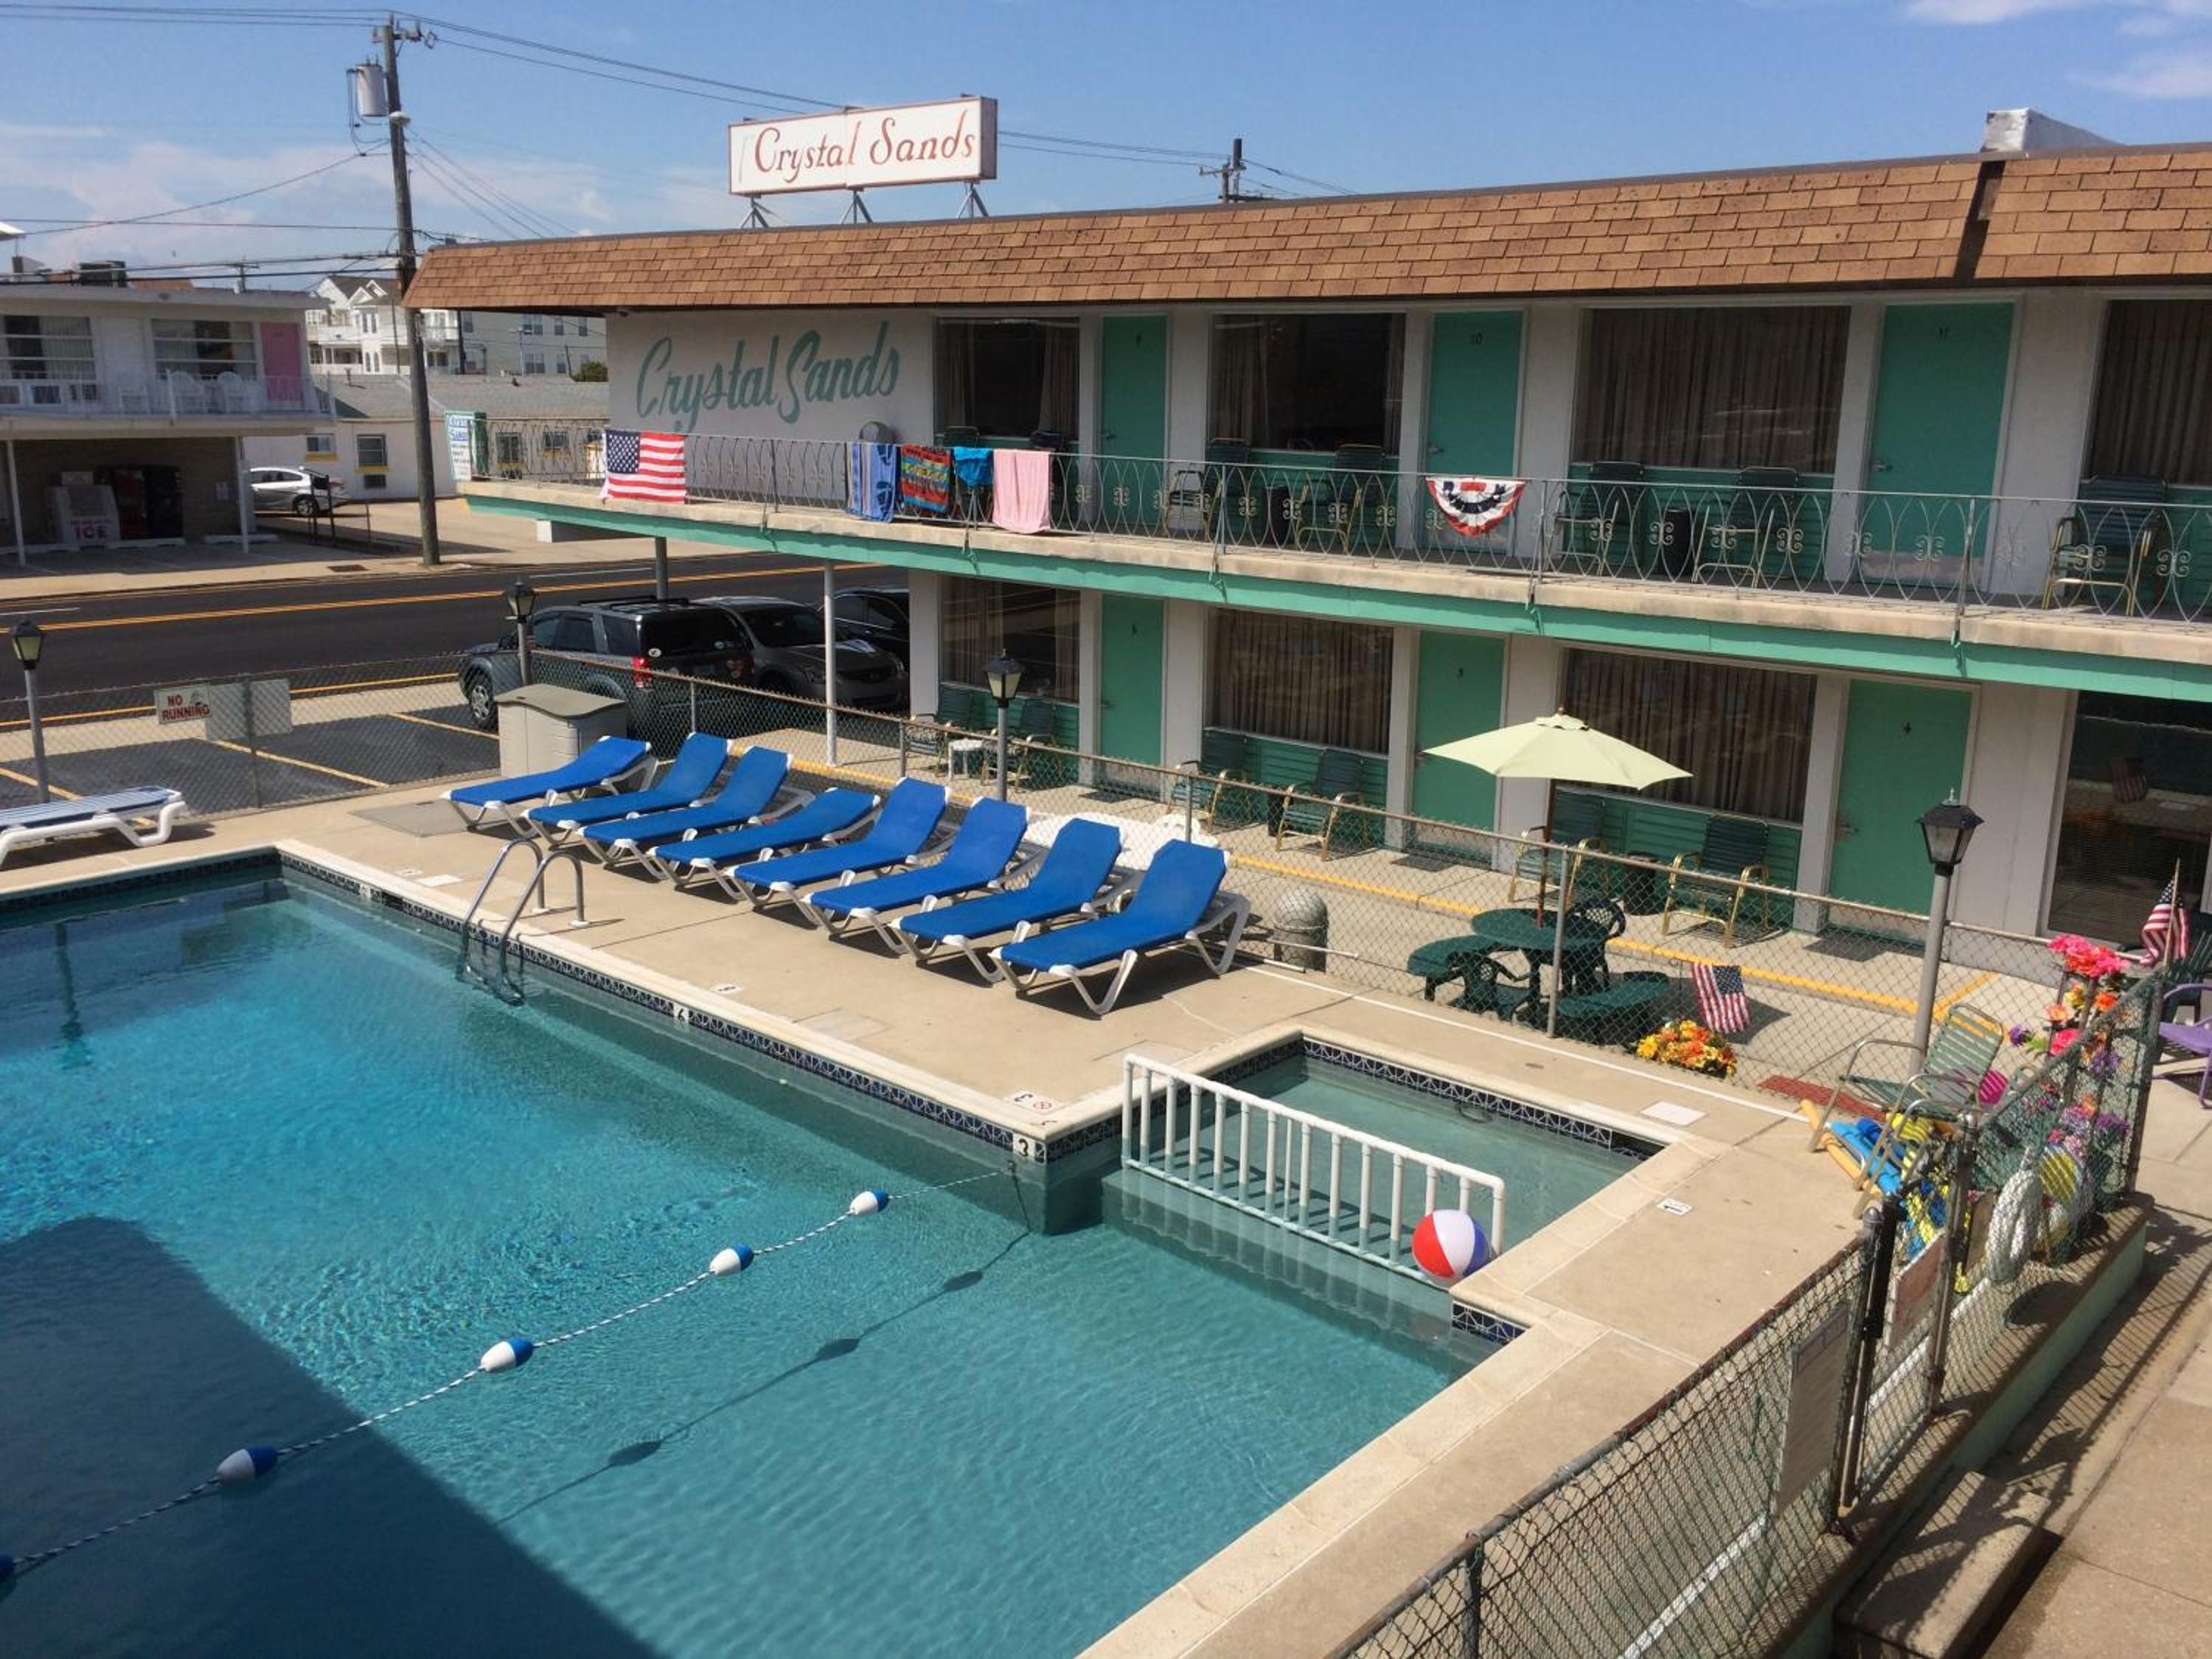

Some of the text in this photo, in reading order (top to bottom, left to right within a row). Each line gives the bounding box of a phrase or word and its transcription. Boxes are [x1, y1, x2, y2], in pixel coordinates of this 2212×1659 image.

[754, 108, 975, 184] Crystal Sands
[636, 319, 900, 433] Crystal Sands
[73, 524, 108, 539] ICE
[167, 694, 183, 706] NO
[161, 704, 210, 720] RUNNING
[1018, 1138, 1029, 1157] 3
